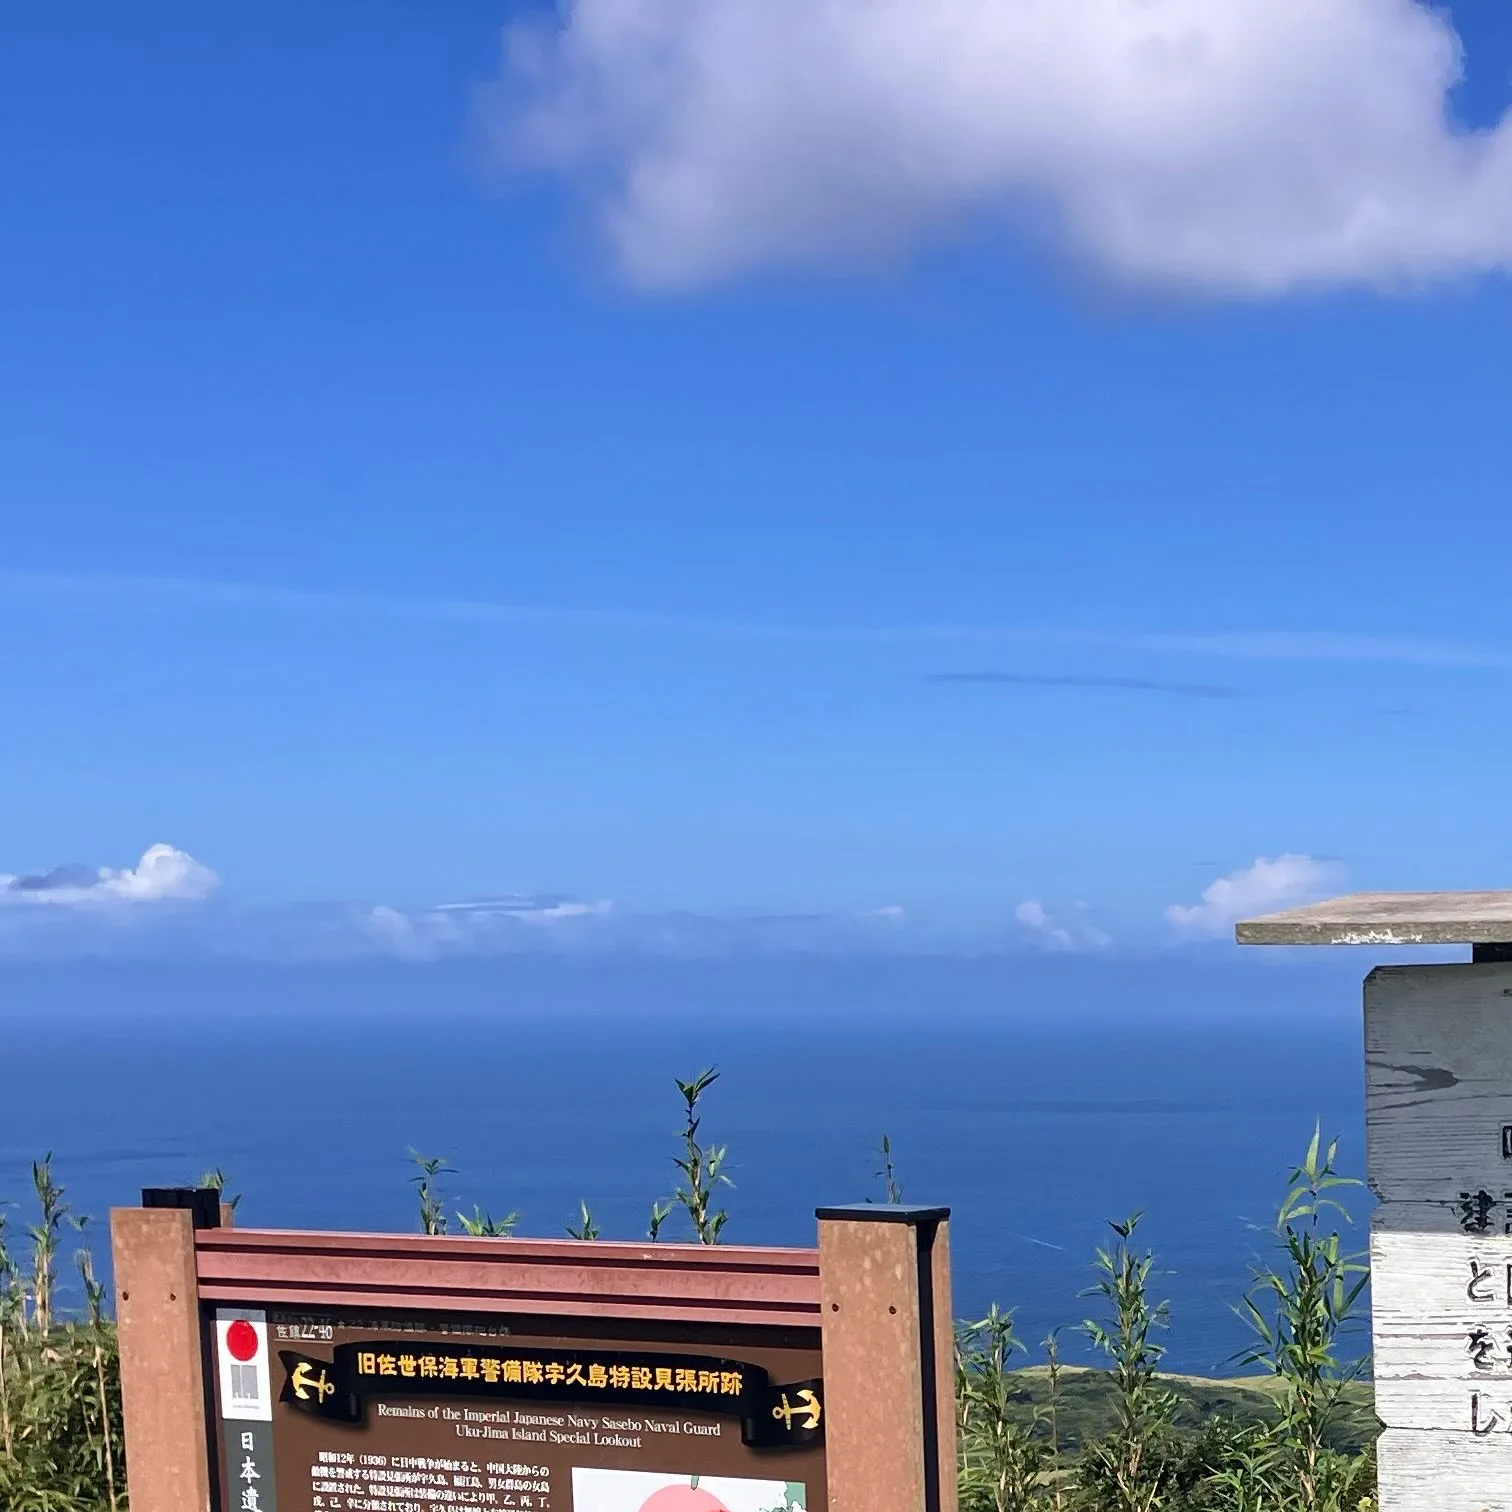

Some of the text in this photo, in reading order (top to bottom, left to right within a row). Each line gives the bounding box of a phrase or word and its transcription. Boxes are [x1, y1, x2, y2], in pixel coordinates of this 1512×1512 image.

[357, 1351, 743, 1396] 旧佐世保海軍警備隊宇久島特設見張所跡
[378, 1403, 721, 1437] Remains of the Imperial Japanese Navy Sasebo Naval Guard
[512, 1427, 547, 1442] Island
[549, 1430, 590, 1445] Special
[594, 1432, 642, 1448] Lookout
